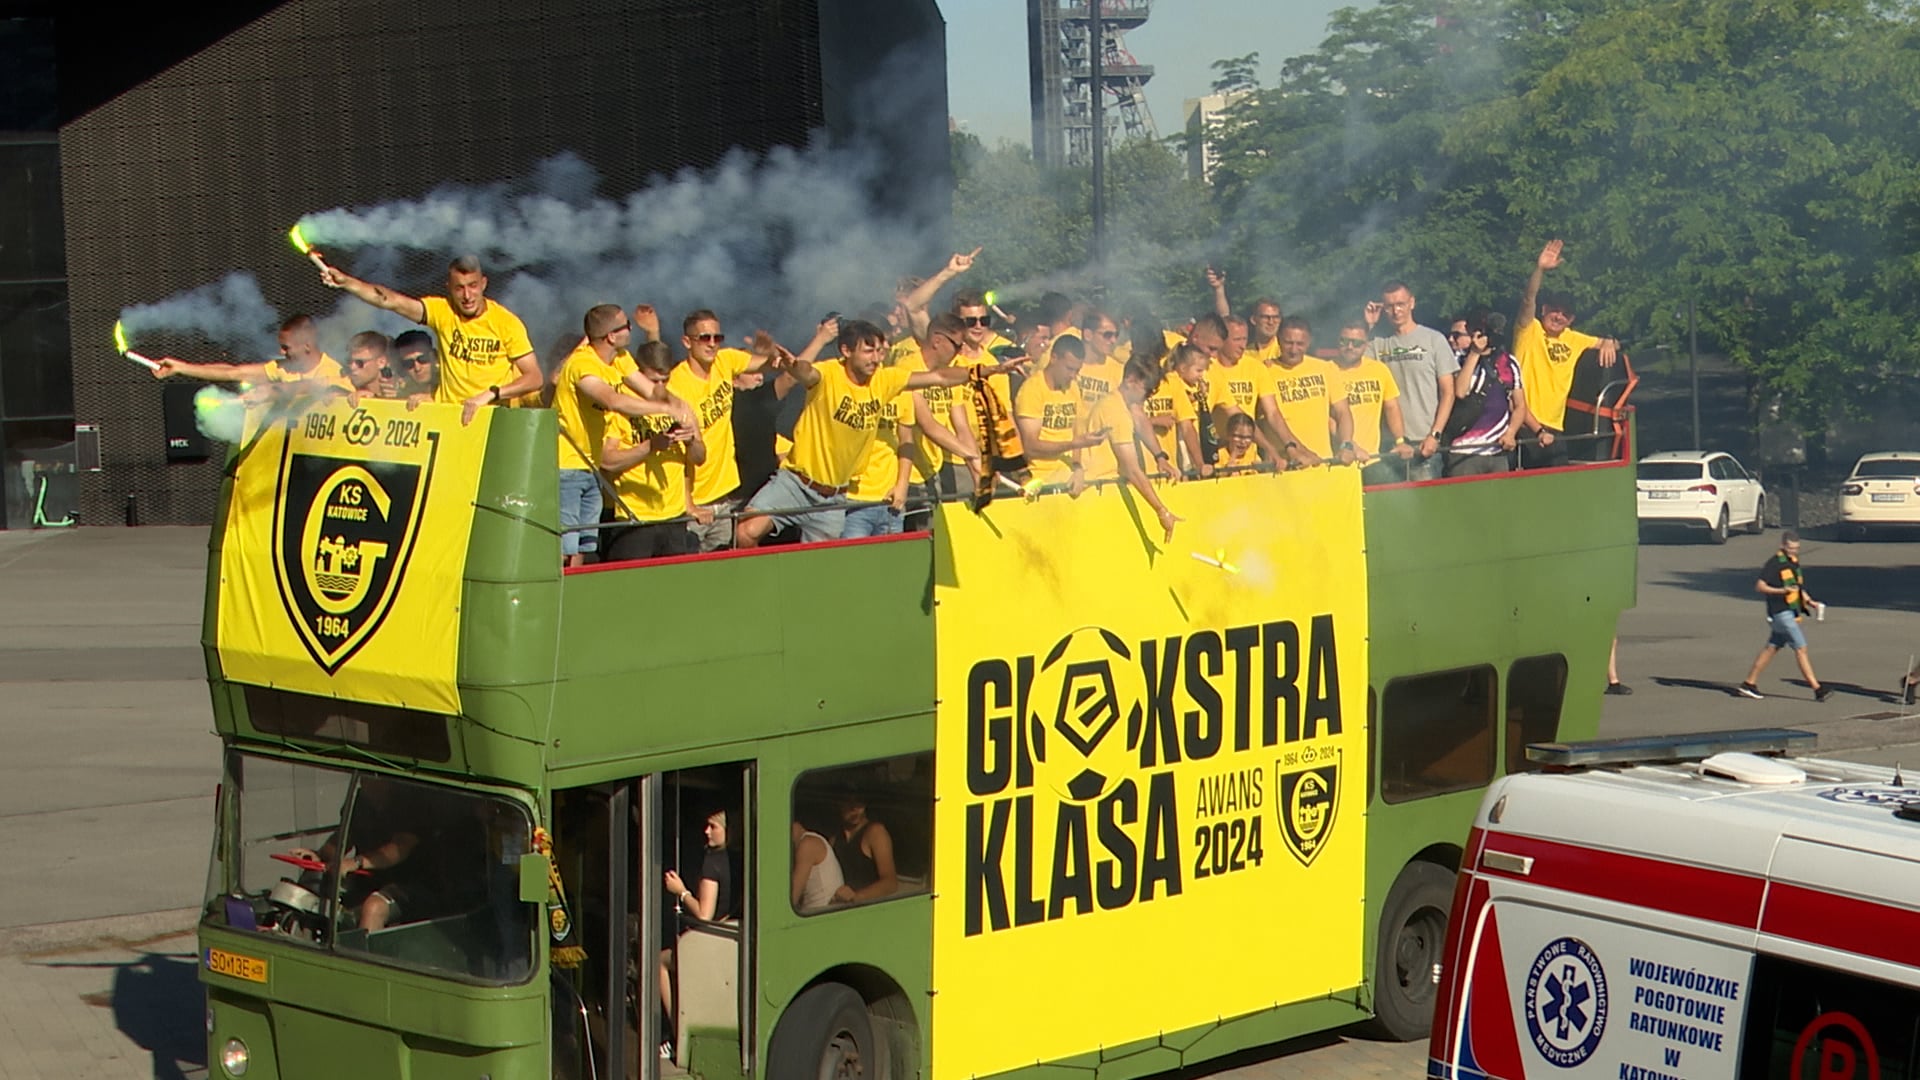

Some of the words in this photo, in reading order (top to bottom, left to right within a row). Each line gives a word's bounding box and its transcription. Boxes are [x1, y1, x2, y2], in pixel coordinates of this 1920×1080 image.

[304, 413, 336, 440] 1964
[384, 419, 421, 447] 2024
[327, 505, 368, 521] KATOWICE
[339, 484, 362, 505] KS
[316, 615, 350, 638] 1964
[1196, 767, 1263, 819] AWANS
[964, 771, 1183, 938] KLASA
[1195, 815, 1263, 879] 2024
[1629, 957, 1739, 1000] WOJEWÓDZKIE
[1634, 985, 1725, 1025] POGOTOWIE
[1535, 1033, 1588, 1065] MEDYCZNE
[1629, 1011, 1723, 1052] RATUNKOWE
[1664, 1047, 1681, 1068] W
